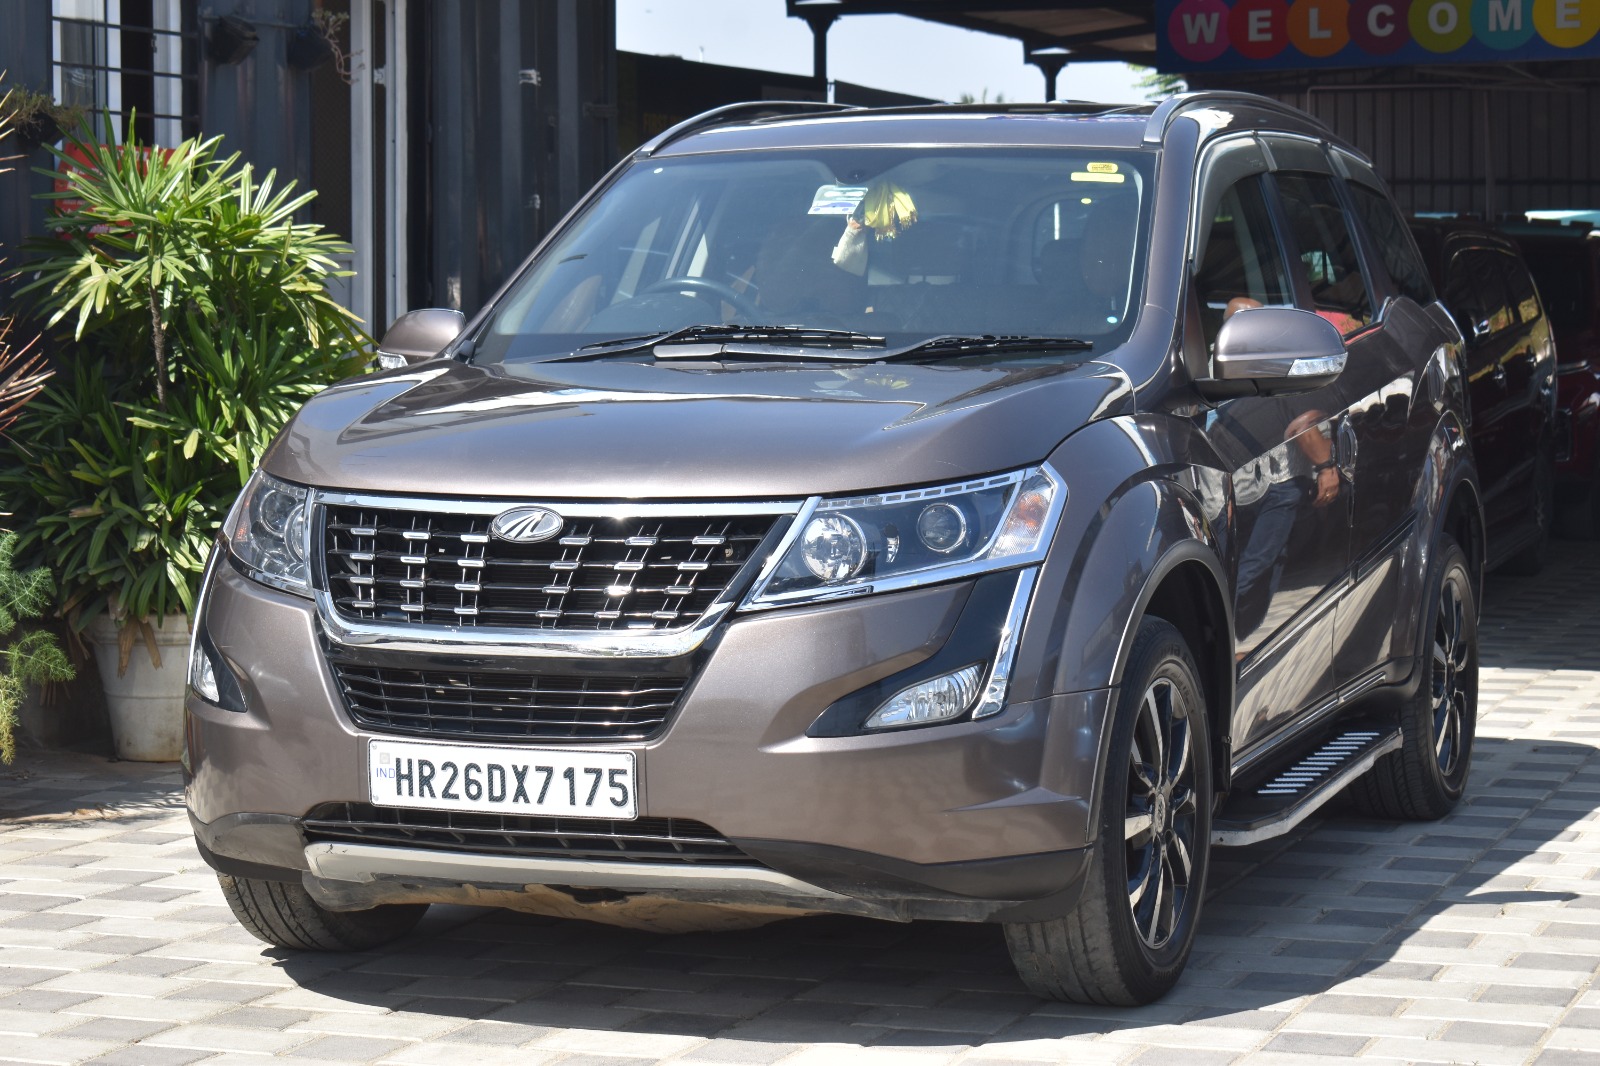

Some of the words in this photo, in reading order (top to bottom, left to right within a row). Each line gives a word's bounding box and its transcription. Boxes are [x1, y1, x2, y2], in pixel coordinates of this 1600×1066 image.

[1182, 0, 1581, 44] WELCOME
[376, 767, 396, 779] IND
[395, 757, 629, 807] HR26DX7175
